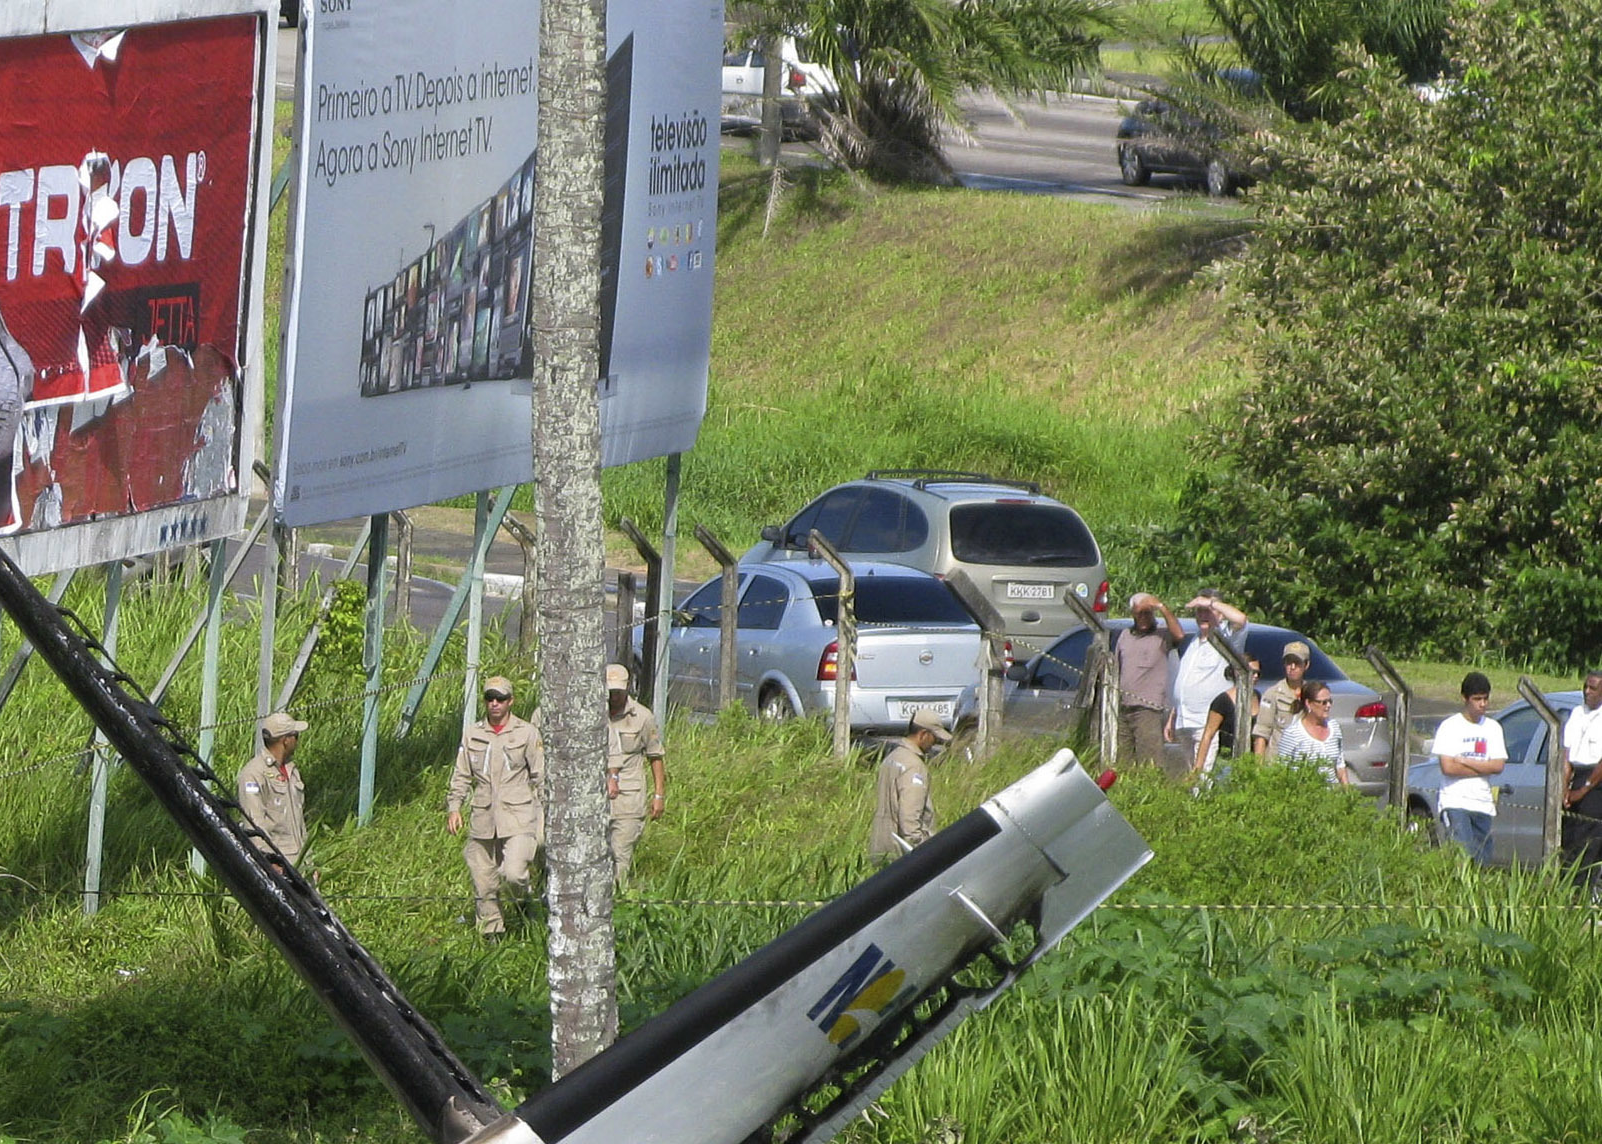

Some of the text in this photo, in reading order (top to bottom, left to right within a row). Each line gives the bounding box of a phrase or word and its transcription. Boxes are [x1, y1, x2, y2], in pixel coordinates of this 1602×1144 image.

[318, 56, 535, 122] Primeiro a TV. Depois a internet.
[314, 116, 492, 187] Agora a Sony Internet TV.
[651, 110, 706, 152] televisão
[649, 152, 705, 196] ilimitada
